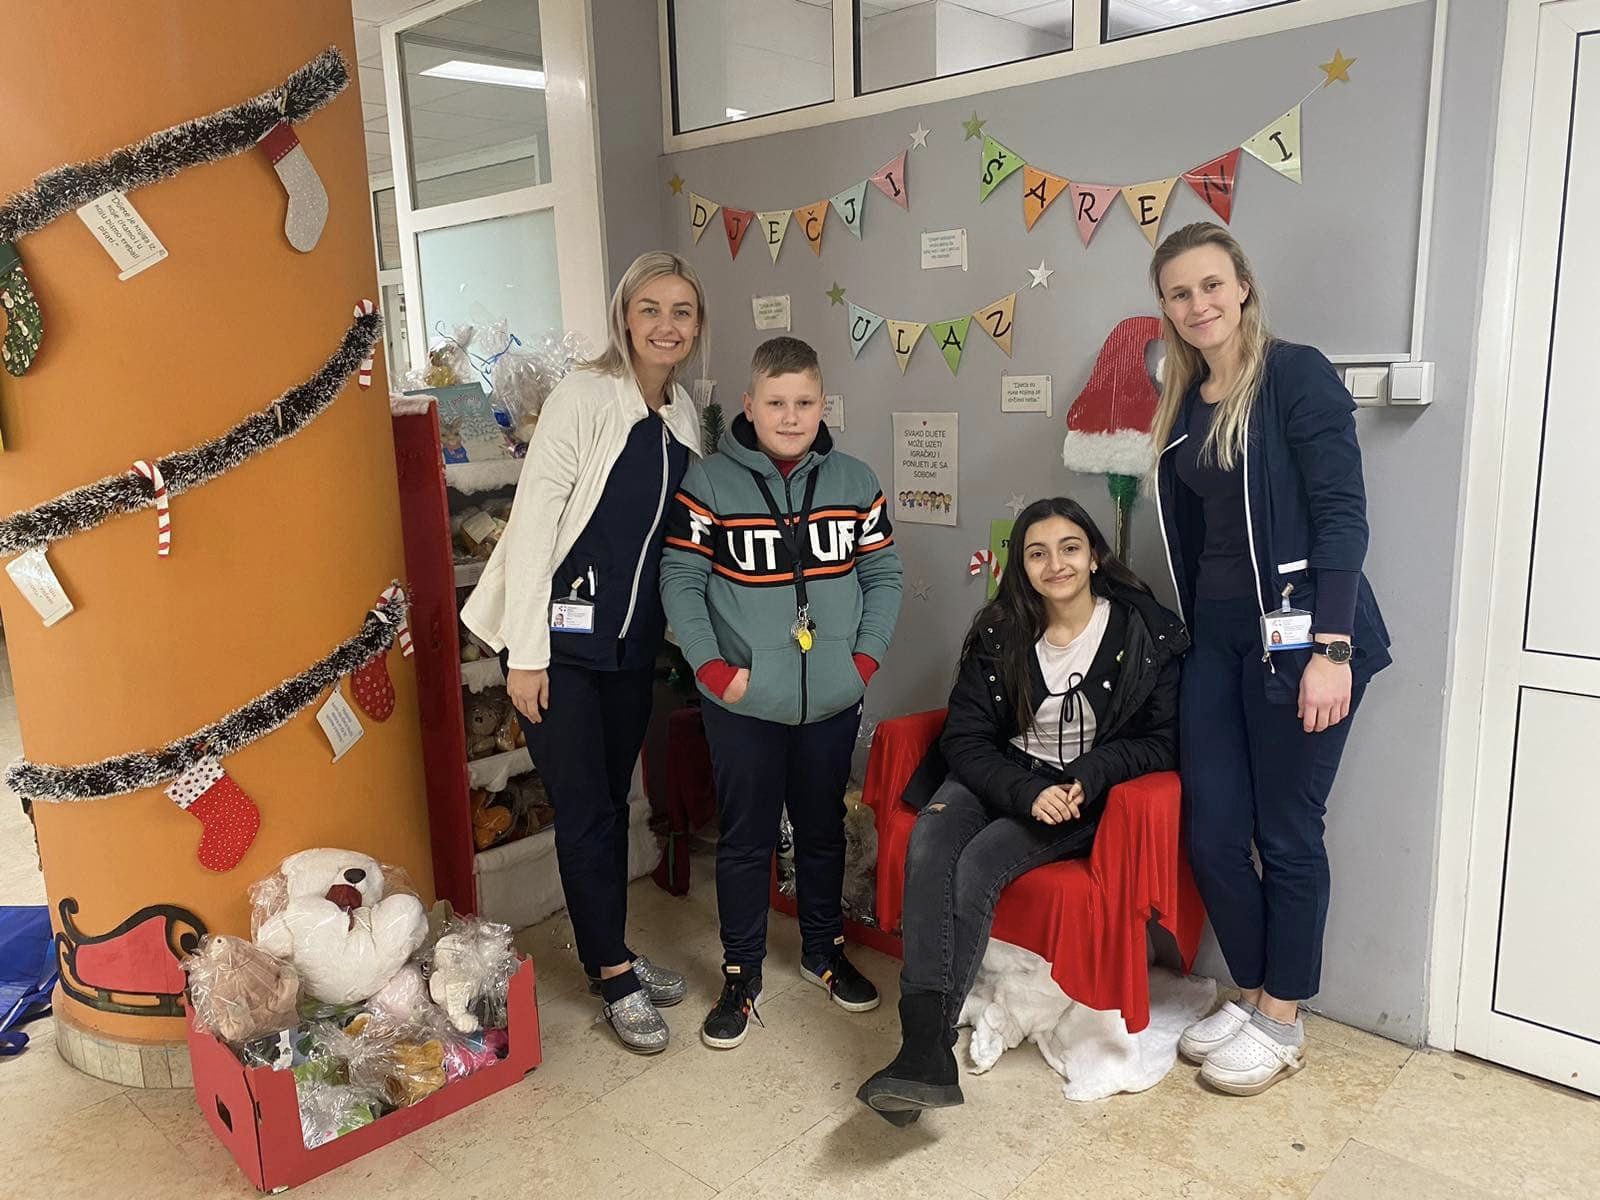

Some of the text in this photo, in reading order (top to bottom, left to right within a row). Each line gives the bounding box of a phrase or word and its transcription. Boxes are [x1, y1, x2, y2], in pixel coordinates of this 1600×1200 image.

[982, 131, 1293, 226] ŠARENI
[692, 172, 901, 245] DJEČJI
[851, 310, 1011, 354] ULAZ
[903, 429, 946, 438] SVAKO DIJETE
[907, 438, 942, 448] MOŽE UZETI
[910, 449, 936, 458] IGRAČKU
[902, 459, 948, 469] PONIJETI JE SA
